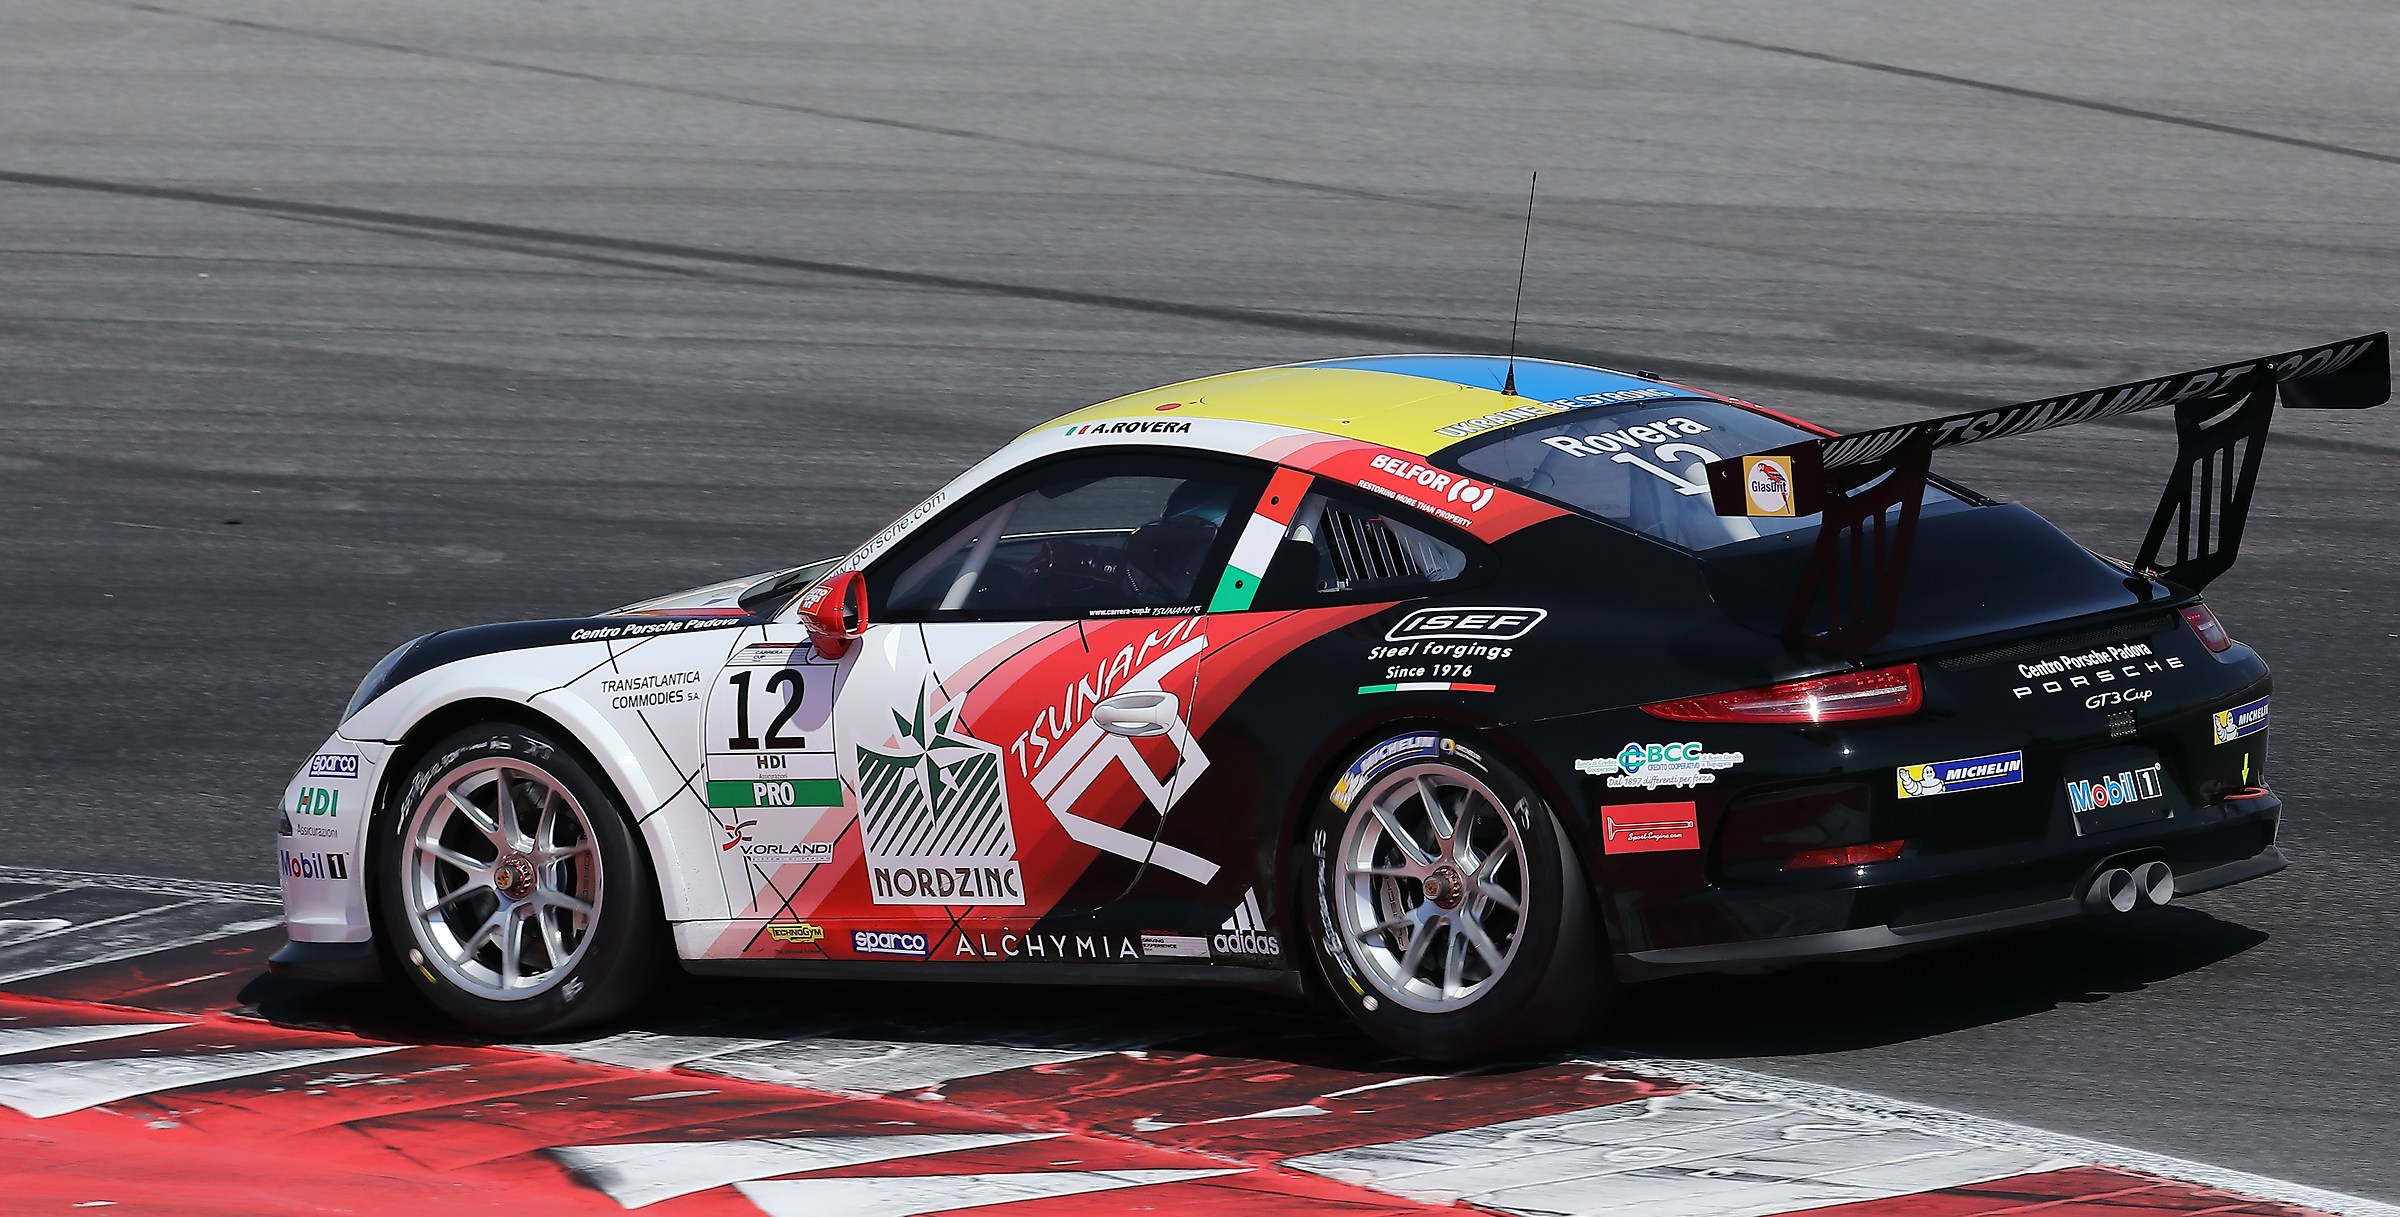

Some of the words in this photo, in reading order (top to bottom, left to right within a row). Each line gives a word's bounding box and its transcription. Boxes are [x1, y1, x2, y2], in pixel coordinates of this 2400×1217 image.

[1434, 405, 1553, 437] UKRAINE
[1538, 399, 1587, 412] BE
[1574, 388, 1676, 405] STRONG
[1091, 421, 1192, 434] A.ROVERA
[1541, 416, 1713, 458] Rovera
[1370, 453, 1452, 493] BELFOR
[1751, 480, 1787, 493] Glasurit
[1357, 480, 1397, 499] RESTORING
[1395, 493, 1417, 507] MORE
[1417, 501, 1438, 514] THAN
[1435, 509, 1473, 528] PROPERTY
[570, 627, 622, 641] Centro
[621, 620, 684, 636] Porsche
[683, 617, 740, 630] Padova
[1402, 614, 1529, 632] ISEF
[1367, 642, 1420, 661] Steel
[1421, 641, 1513, 661] forgings
[2017, 660, 2066, 679] Centro
[2059, 650, 2113, 671] Porsche
[2106, 643, 2153, 661] Padova
[601, 671, 701, 693] TRANSATLANTICA
[1385, 666, 1426, 680] Since
[1432, 664, 1473, 678] 1976
[2012, 656, 2185, 700] PORSCHE
[612, 690, 684, 710] COMMODIES
[1010, 615, 1202, 778] TSUNAMI
[2085, 691, 2122, 709] GT3
[2123, 688, 2153, 702] Cup
[729, 669, 805, 750] 12
[757, 755, 787, 769] HDI
[1648, 744, 1701, 762] BCC
[312, 755, 357, 775] sparco
[1647, 763, 1668, 772] CREDITO
[1668, 762, 1701, 771] COOPERATIVO
[1945, 760, 2021, 781] MICHELIN
[1609, 777, 1623, 786] Dal
[1624, 777, 1642, 785] 1897
[1643, 774, 1678, 789] differenti
[2068, 771, 2138, 813] Mobil
[296, 786, 339, 817] HDI
[753, 782, 795, 806] PRO
[297, 823, 338, 838] Assicurazioni
[740, 844, 832, 855] V.ORLANDI
[280, 850, 325, 879] Mobil
[874, 867, 1018, 898] NORDZINC
[854, 931, 927, 953] sparco
[955, 932, 1140, 959] ALCHYMIA
[1214, 930, 1280, 955] adidas
